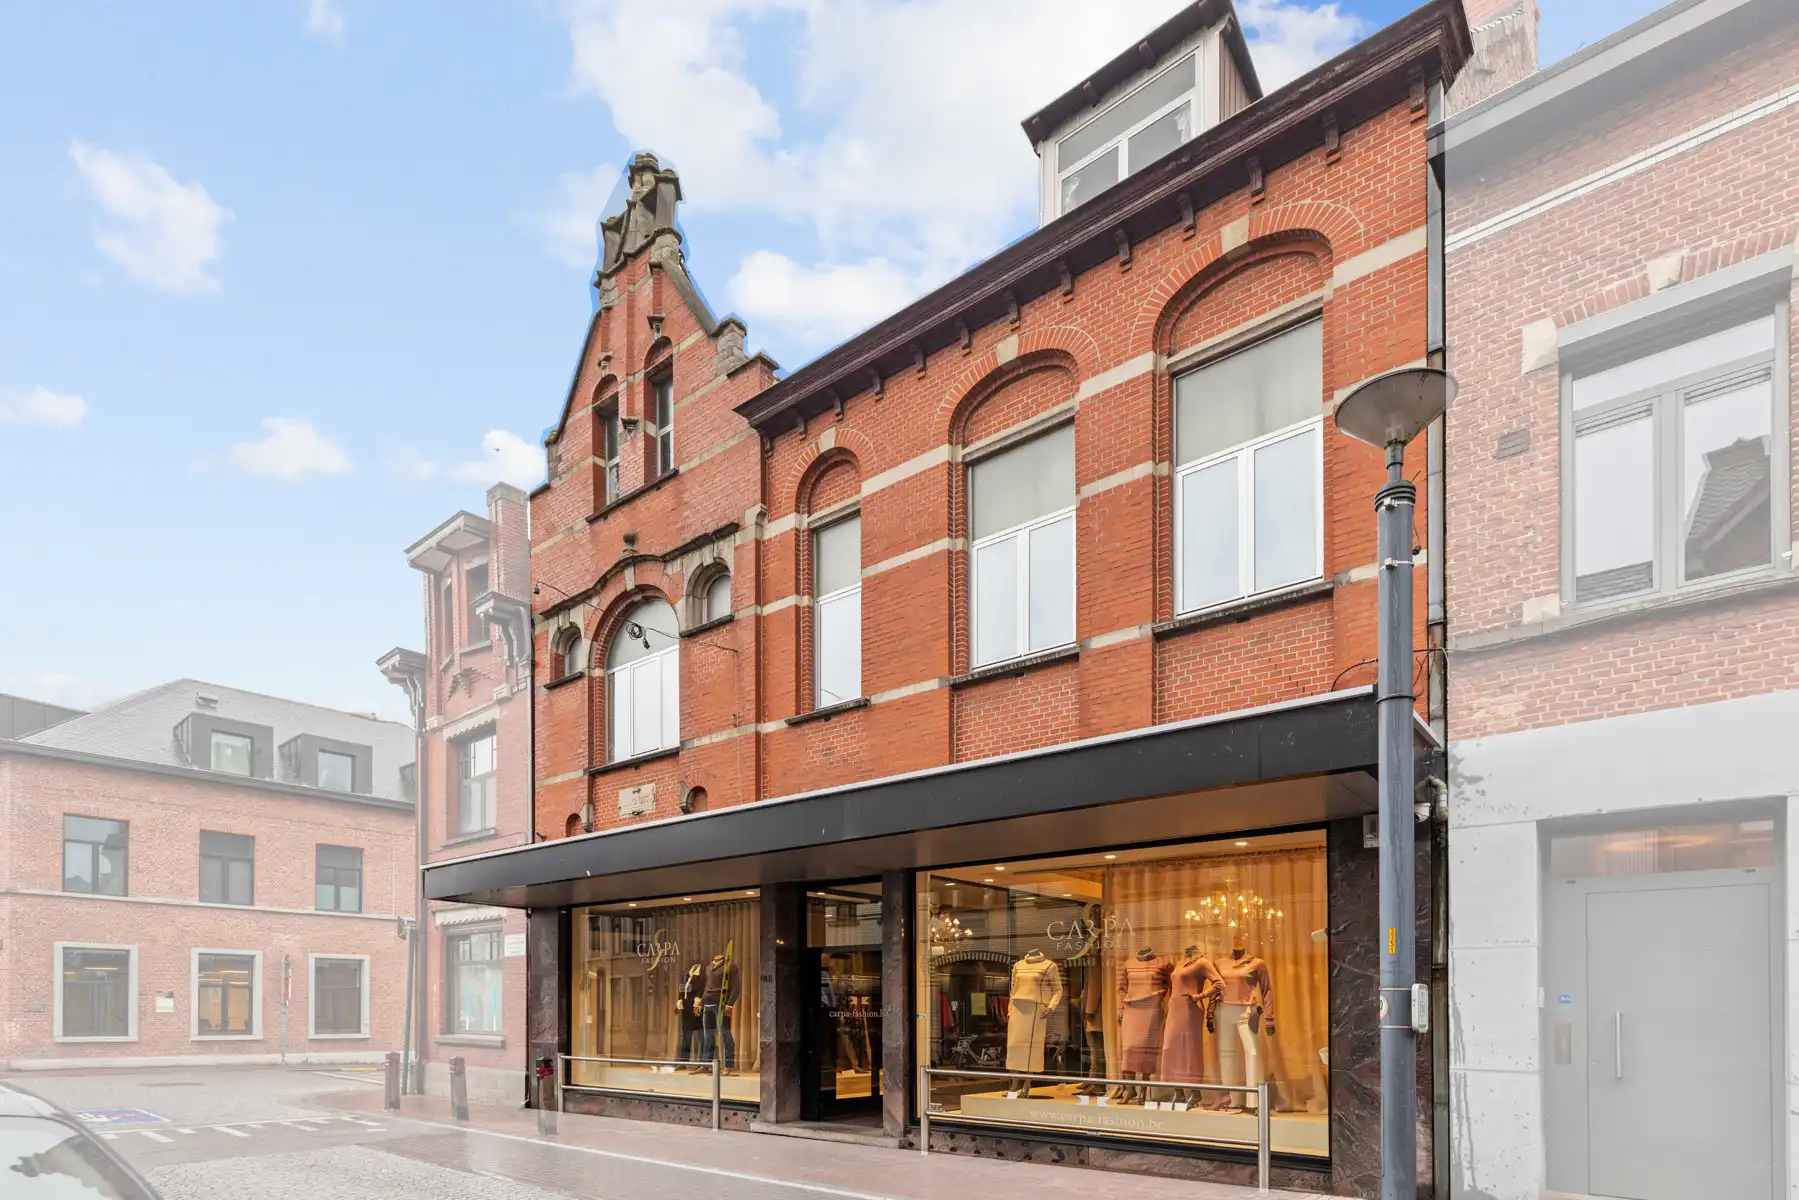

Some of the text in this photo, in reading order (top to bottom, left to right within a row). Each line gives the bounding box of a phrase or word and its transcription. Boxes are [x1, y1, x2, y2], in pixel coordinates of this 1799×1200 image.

[1046, 917, 1137, 941] CARPA
[637, 942, 681, 957] CARPA
[641, 956, 676, 965] FASION
[1029, 1109, 1165, 1130] www.carpafashion.be
